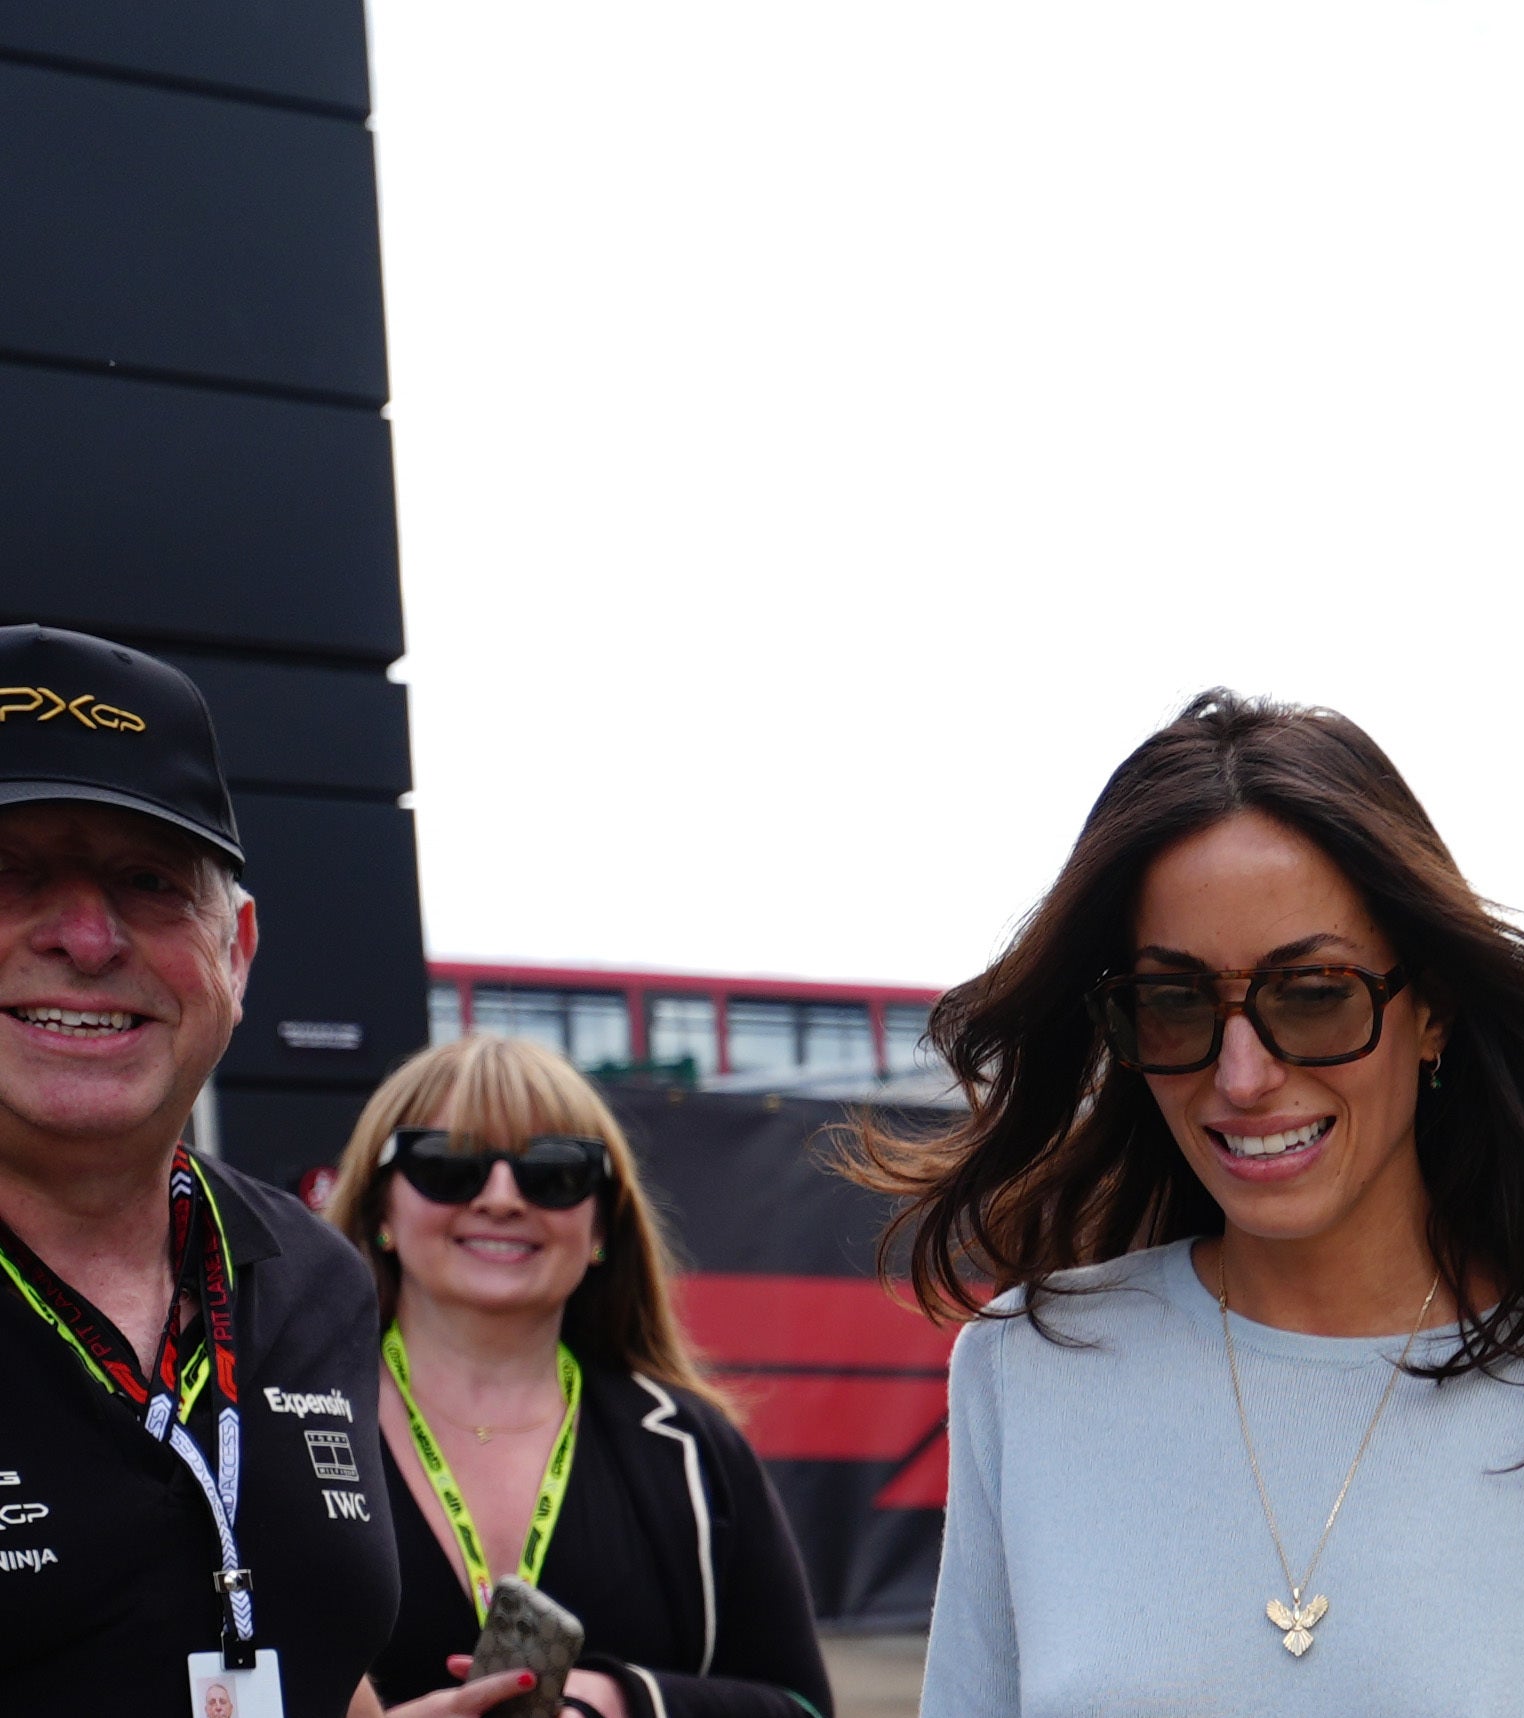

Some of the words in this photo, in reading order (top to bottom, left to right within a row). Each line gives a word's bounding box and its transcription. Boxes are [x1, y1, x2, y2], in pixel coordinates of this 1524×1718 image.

[212, 1310, 234, 1342] PIT
[263, 1386, 354, 1424] Expensify
[222, 1424, 236, 1491] ACCESS
[321, 1489, 371, 1522] IWC
